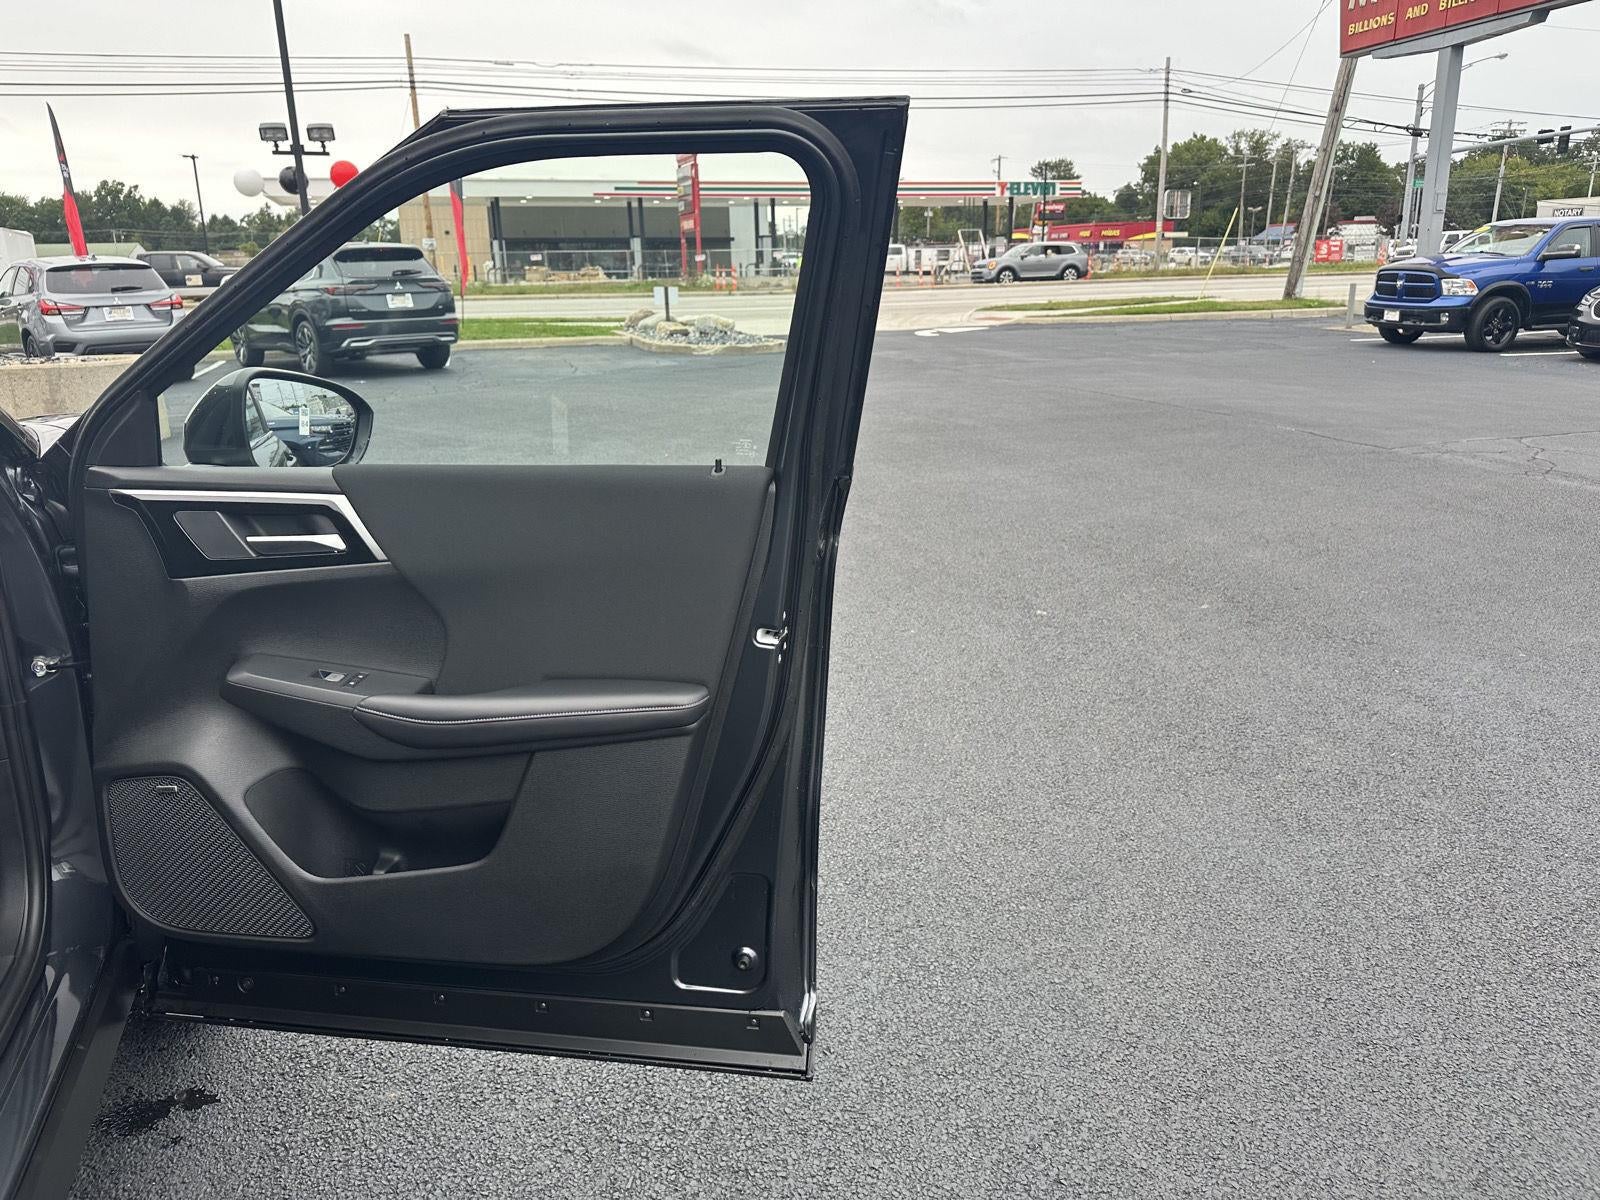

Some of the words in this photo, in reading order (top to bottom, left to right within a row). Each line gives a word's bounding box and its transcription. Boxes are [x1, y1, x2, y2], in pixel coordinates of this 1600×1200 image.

[1348, 12, 1395, 35] BILLIONS
[1405, 3, 1429, 20] AND
[1554, 208, 1582, 218] NOTARY
